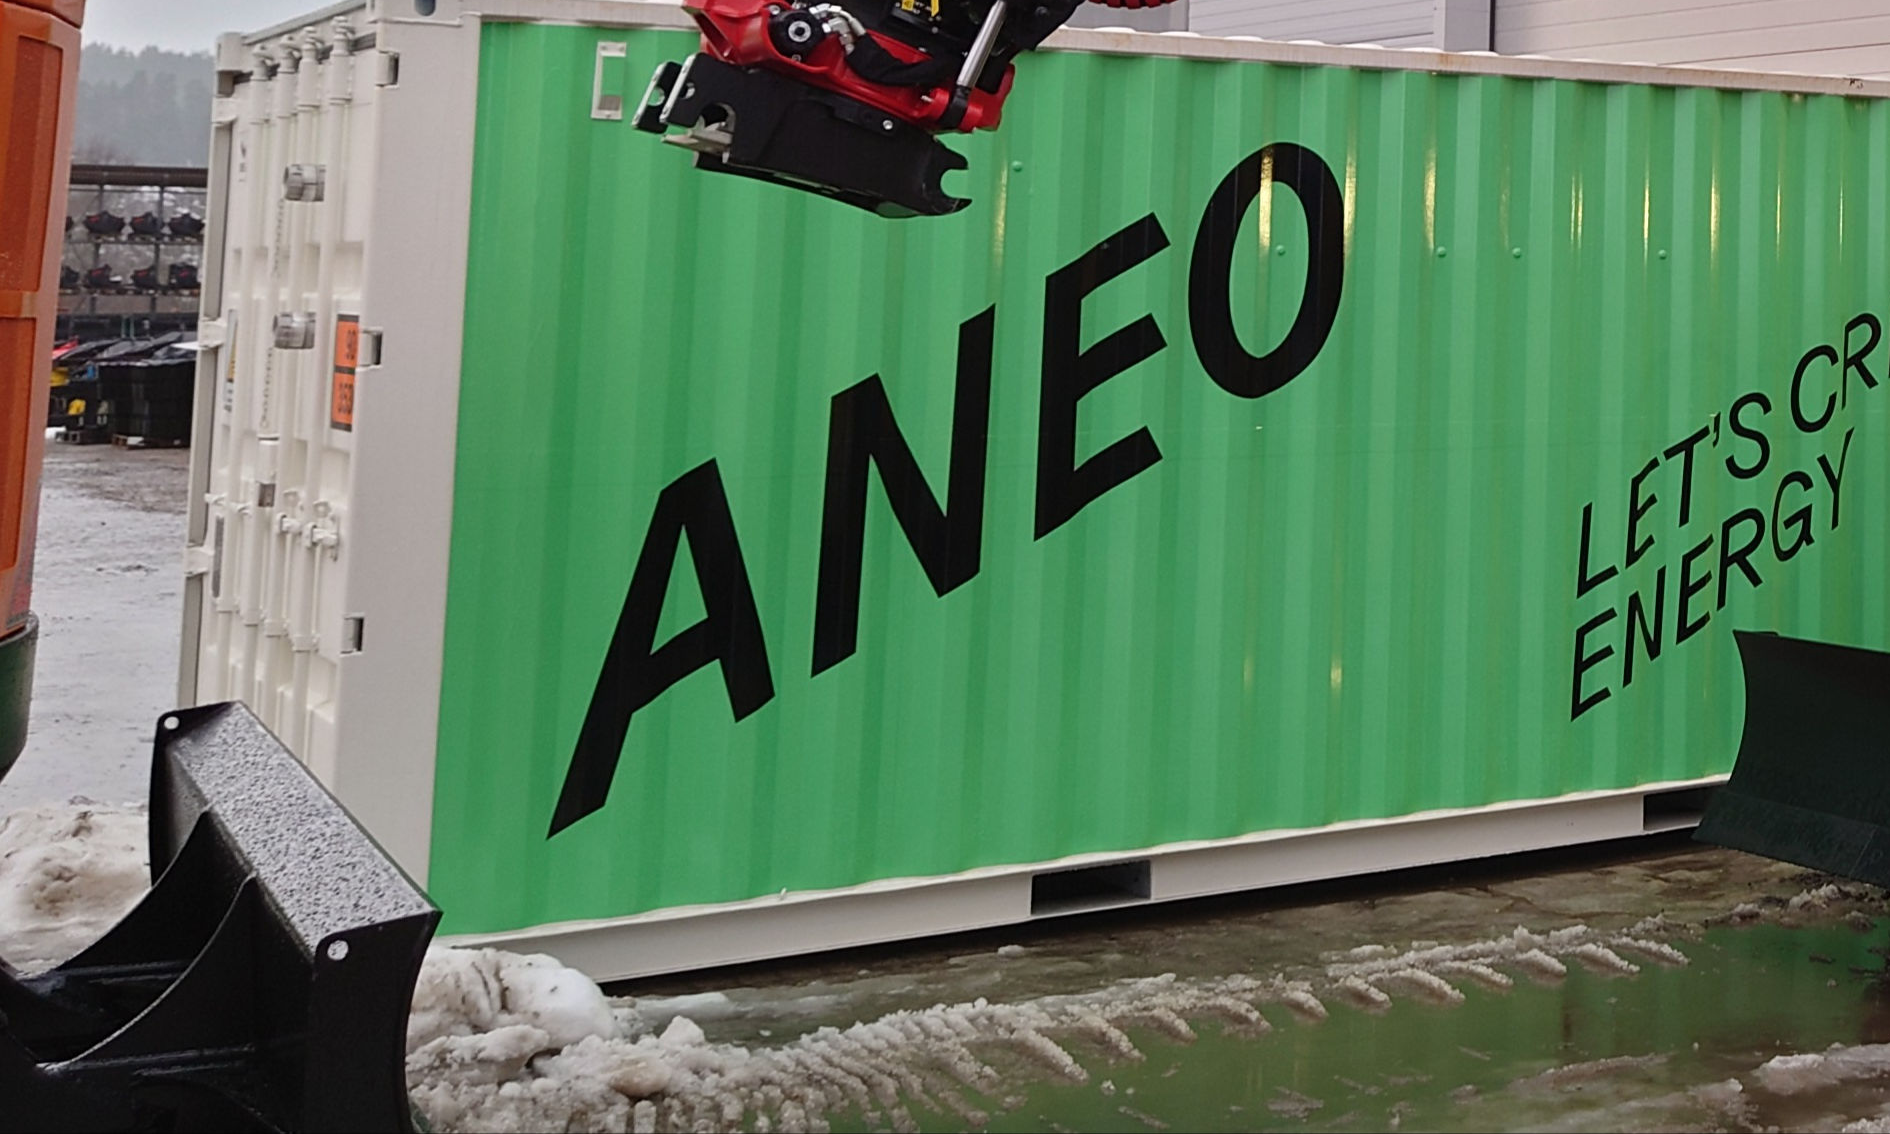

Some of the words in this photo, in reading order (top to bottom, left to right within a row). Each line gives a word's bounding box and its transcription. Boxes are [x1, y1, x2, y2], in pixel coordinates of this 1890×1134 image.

[545, 141, 1345, 841] ANEO
[1570, 426, 1855, 723] ENERGY
[1575, 391, 1773, 600] LET'S
